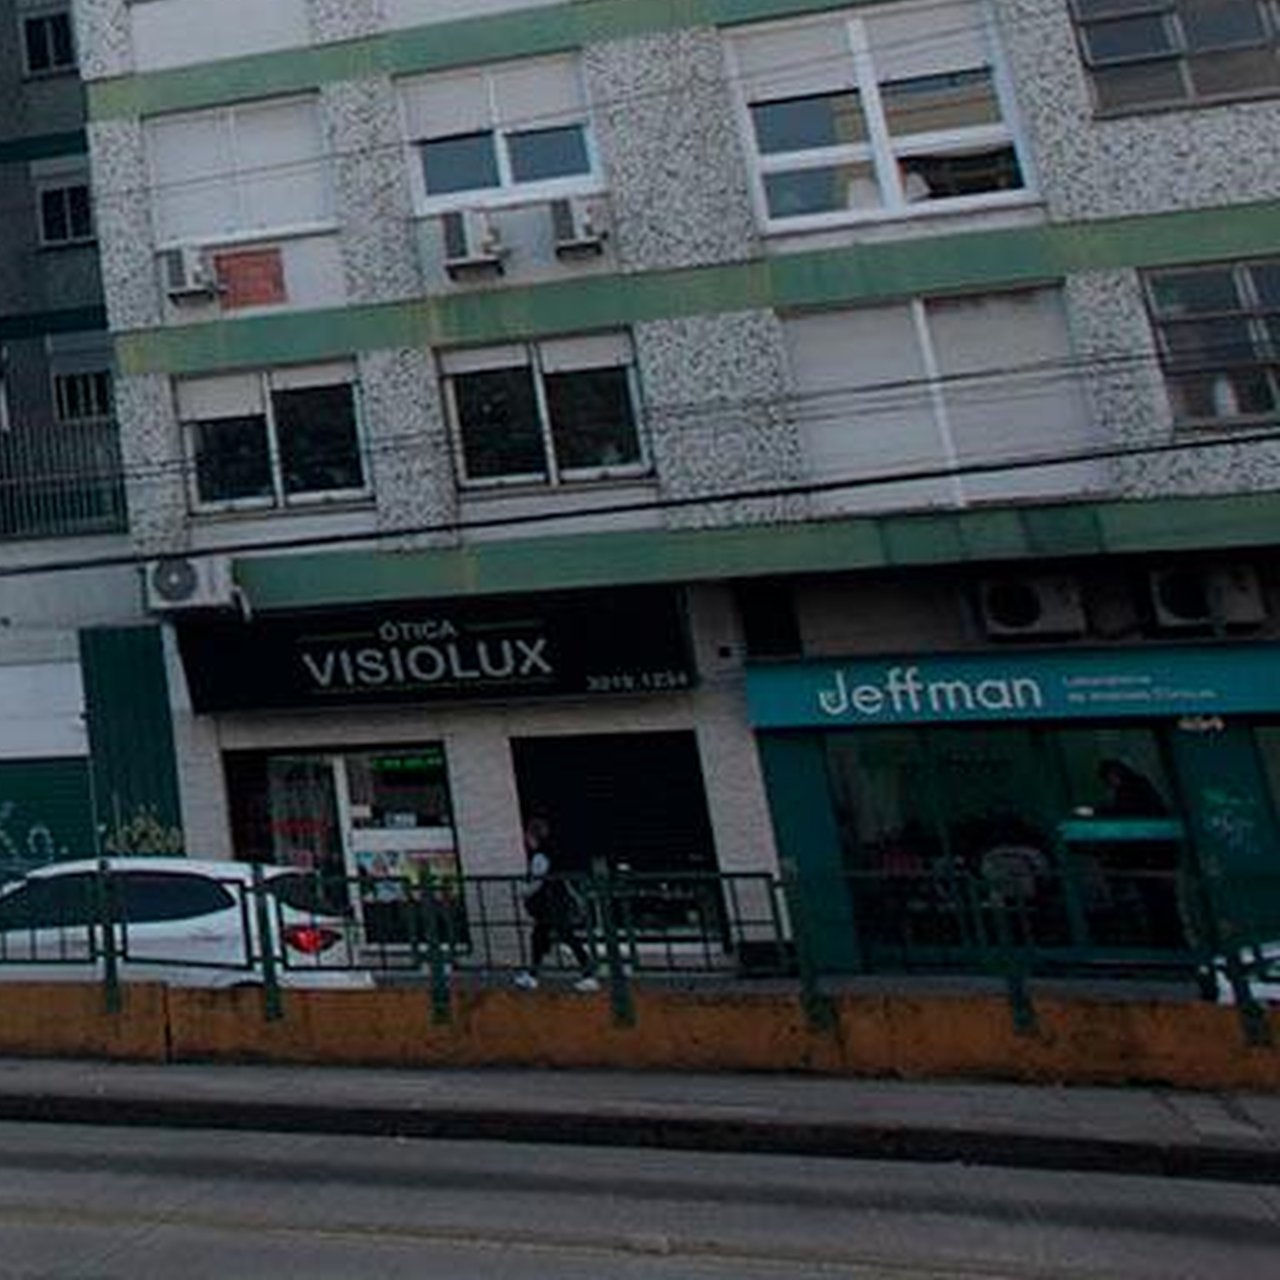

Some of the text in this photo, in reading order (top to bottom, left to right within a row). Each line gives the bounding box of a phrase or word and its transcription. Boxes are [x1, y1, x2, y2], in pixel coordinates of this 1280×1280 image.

[378, 618, 458, 642] ÓTICA
[302, 638, 554, 687] VISIOLUX
[818, 666, 1044, 716] Jeffman
